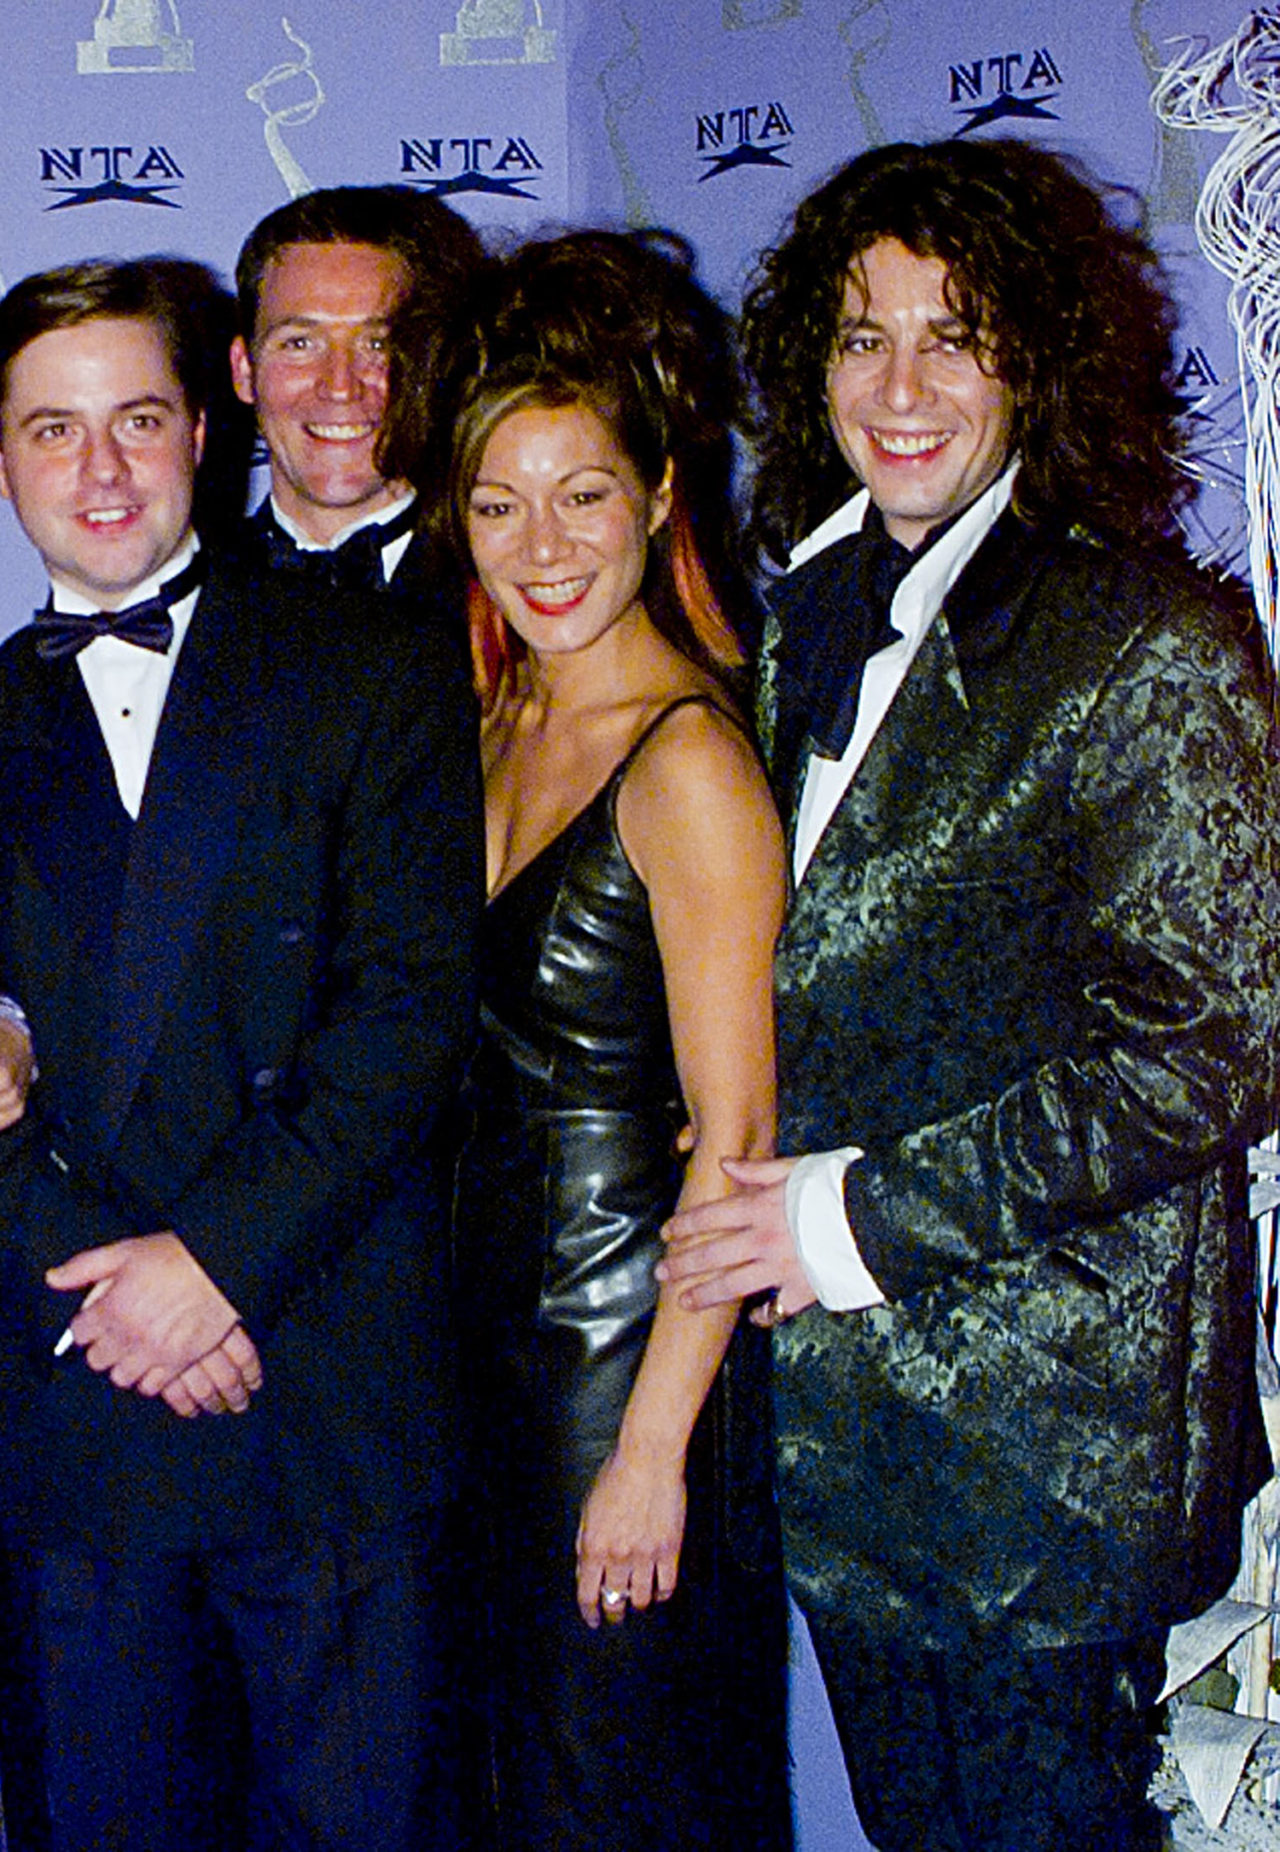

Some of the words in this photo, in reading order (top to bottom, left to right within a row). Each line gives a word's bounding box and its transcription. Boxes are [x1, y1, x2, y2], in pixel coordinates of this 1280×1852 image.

[949, 47, 1064, 103] NTA
[696, 101, 795, 151] NTA
[39, 146, 185, 181] NTA
[400, 137, 543, 172] NTA
